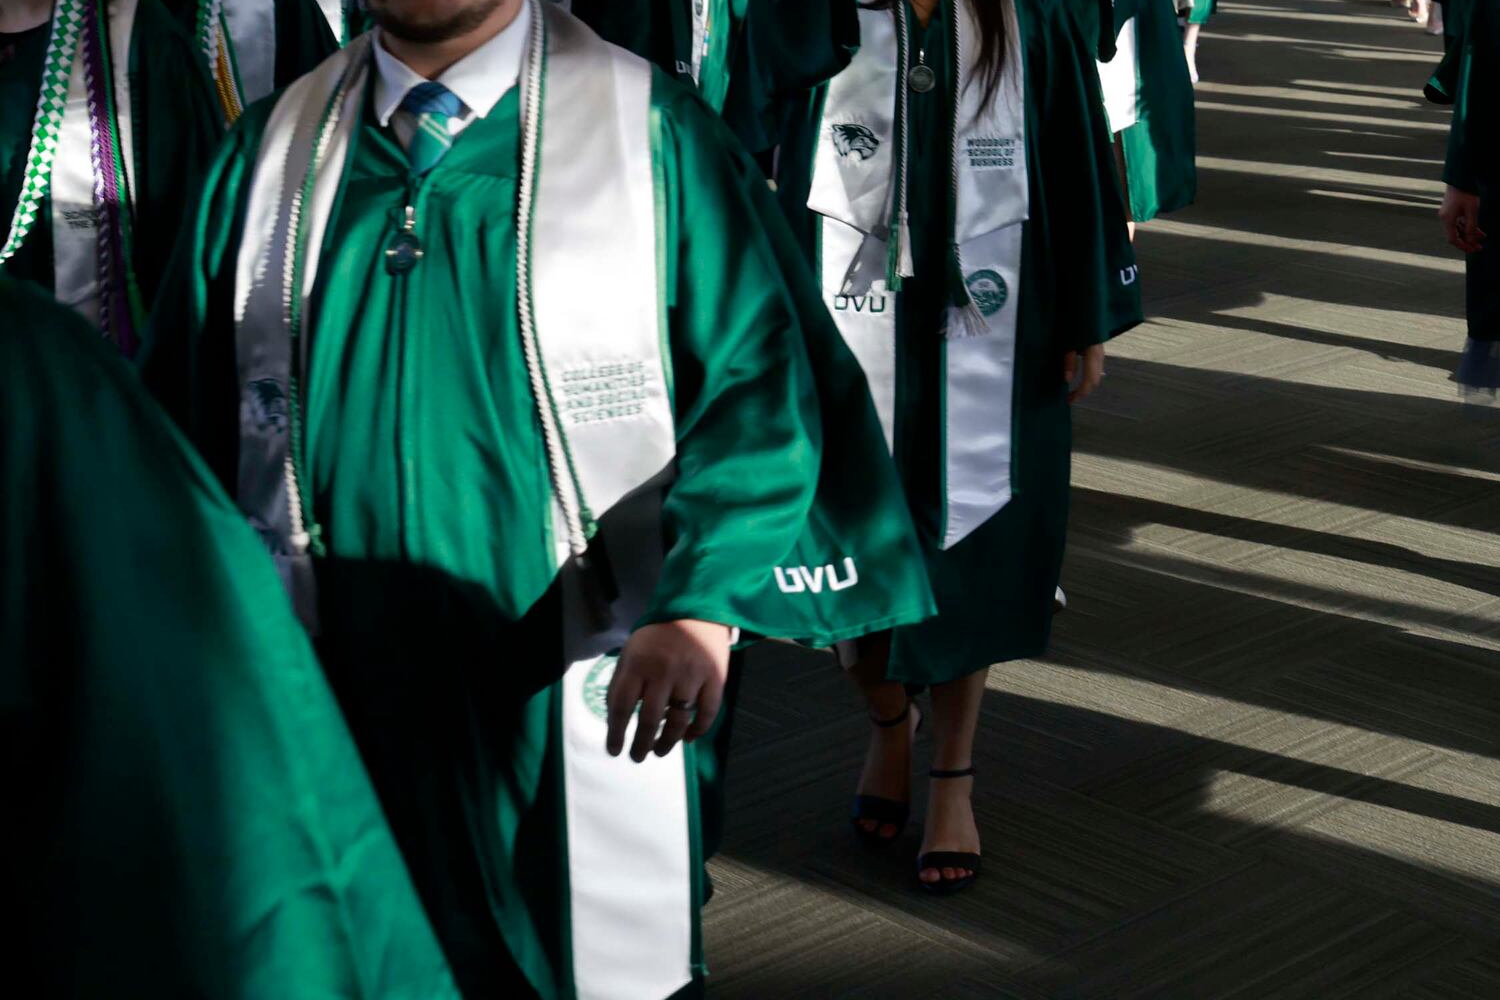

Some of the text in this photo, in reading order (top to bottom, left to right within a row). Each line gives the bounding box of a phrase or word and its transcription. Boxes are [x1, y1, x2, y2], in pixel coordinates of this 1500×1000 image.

[967, 138, 1015, 147] WOODBURY
[967, 148, 1015, 157] SCHOOL OF
[970, 158, 1015, 167] BUSINESS
[834, 295, 886, 313] UVU
[562, 361, 645, 382] COLLEGE OF
[565, 395, 593, 409] AND
[571, 402, 643, 424] SCIENCES
[773, 556, 859, 594] UVU
